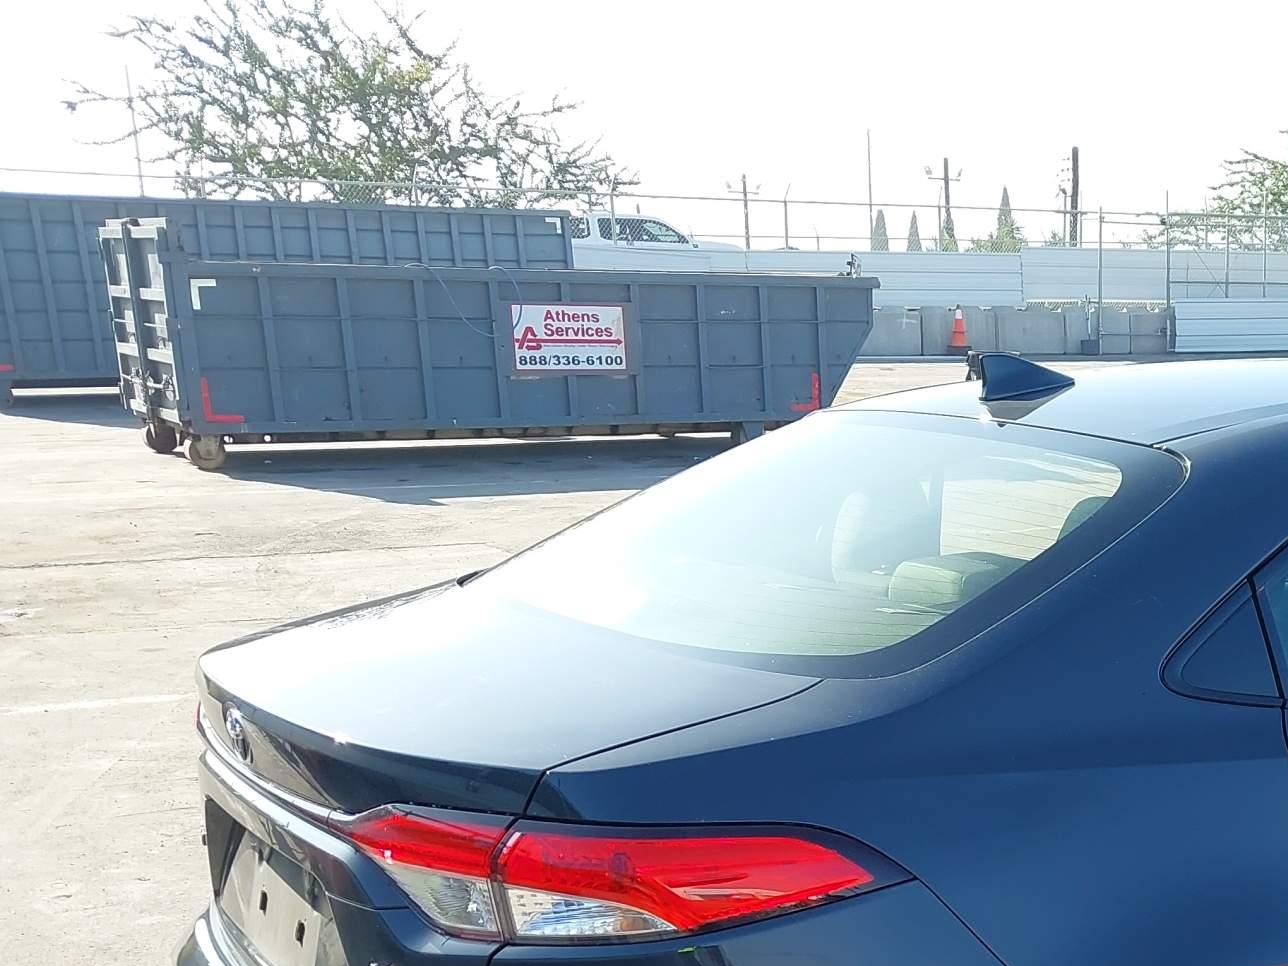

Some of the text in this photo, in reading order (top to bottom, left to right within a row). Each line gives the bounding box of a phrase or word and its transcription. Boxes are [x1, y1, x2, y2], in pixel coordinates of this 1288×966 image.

[544, 310, 600, 323] Athens
[544, 323, 613, 338] Services
[518, 355, 623, 366] 888/336-6100
